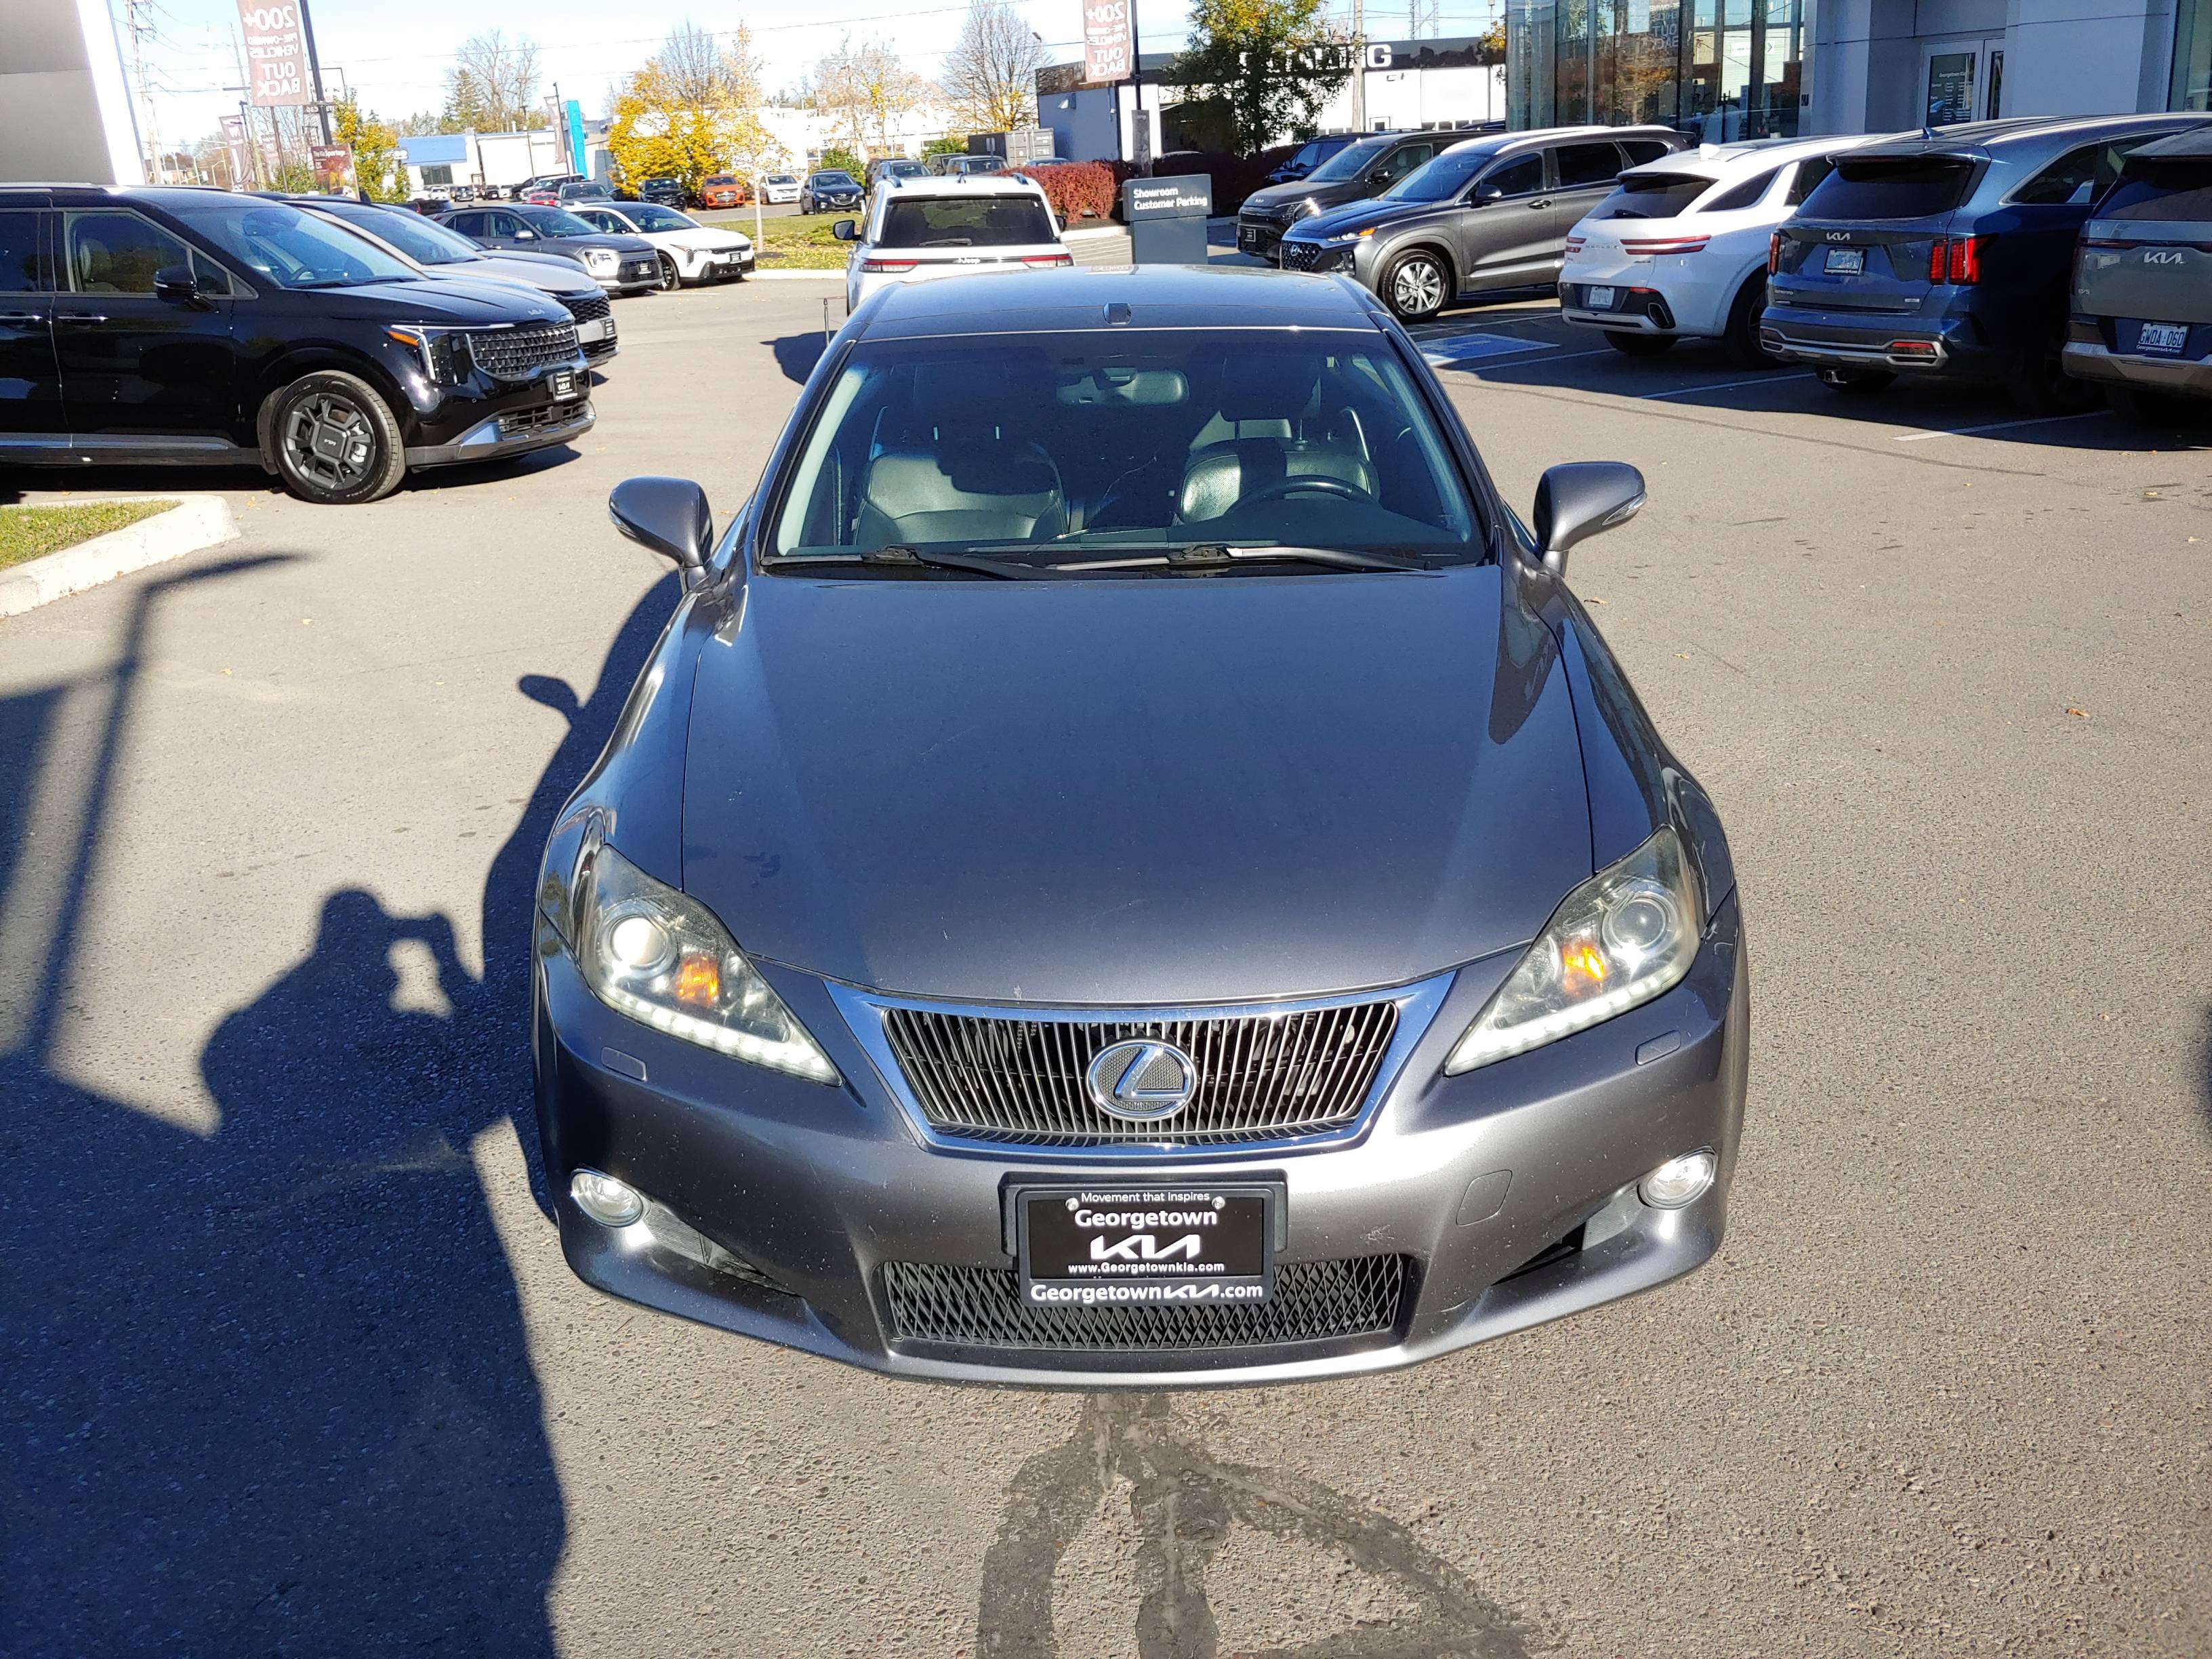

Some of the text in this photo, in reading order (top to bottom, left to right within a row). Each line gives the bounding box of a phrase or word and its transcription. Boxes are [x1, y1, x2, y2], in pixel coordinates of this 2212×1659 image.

[1133, 187, 1179, 199] Showroom
[1134, 195, 1208, 210] Customer Parking
[1826, 232, 1851, 241] KIA
[2144, 251, 2182, 264] KIA
[1081, 1191, 1141, 1203] Movement
[1143, 1191, 1165, 1202] that
[1074, 1209, 1218, 1229] Georgetown
[1090, 1234, 1200, 1260] KIA
[1068, 1261, 1225, 1275] www.Georgetownkia.com
